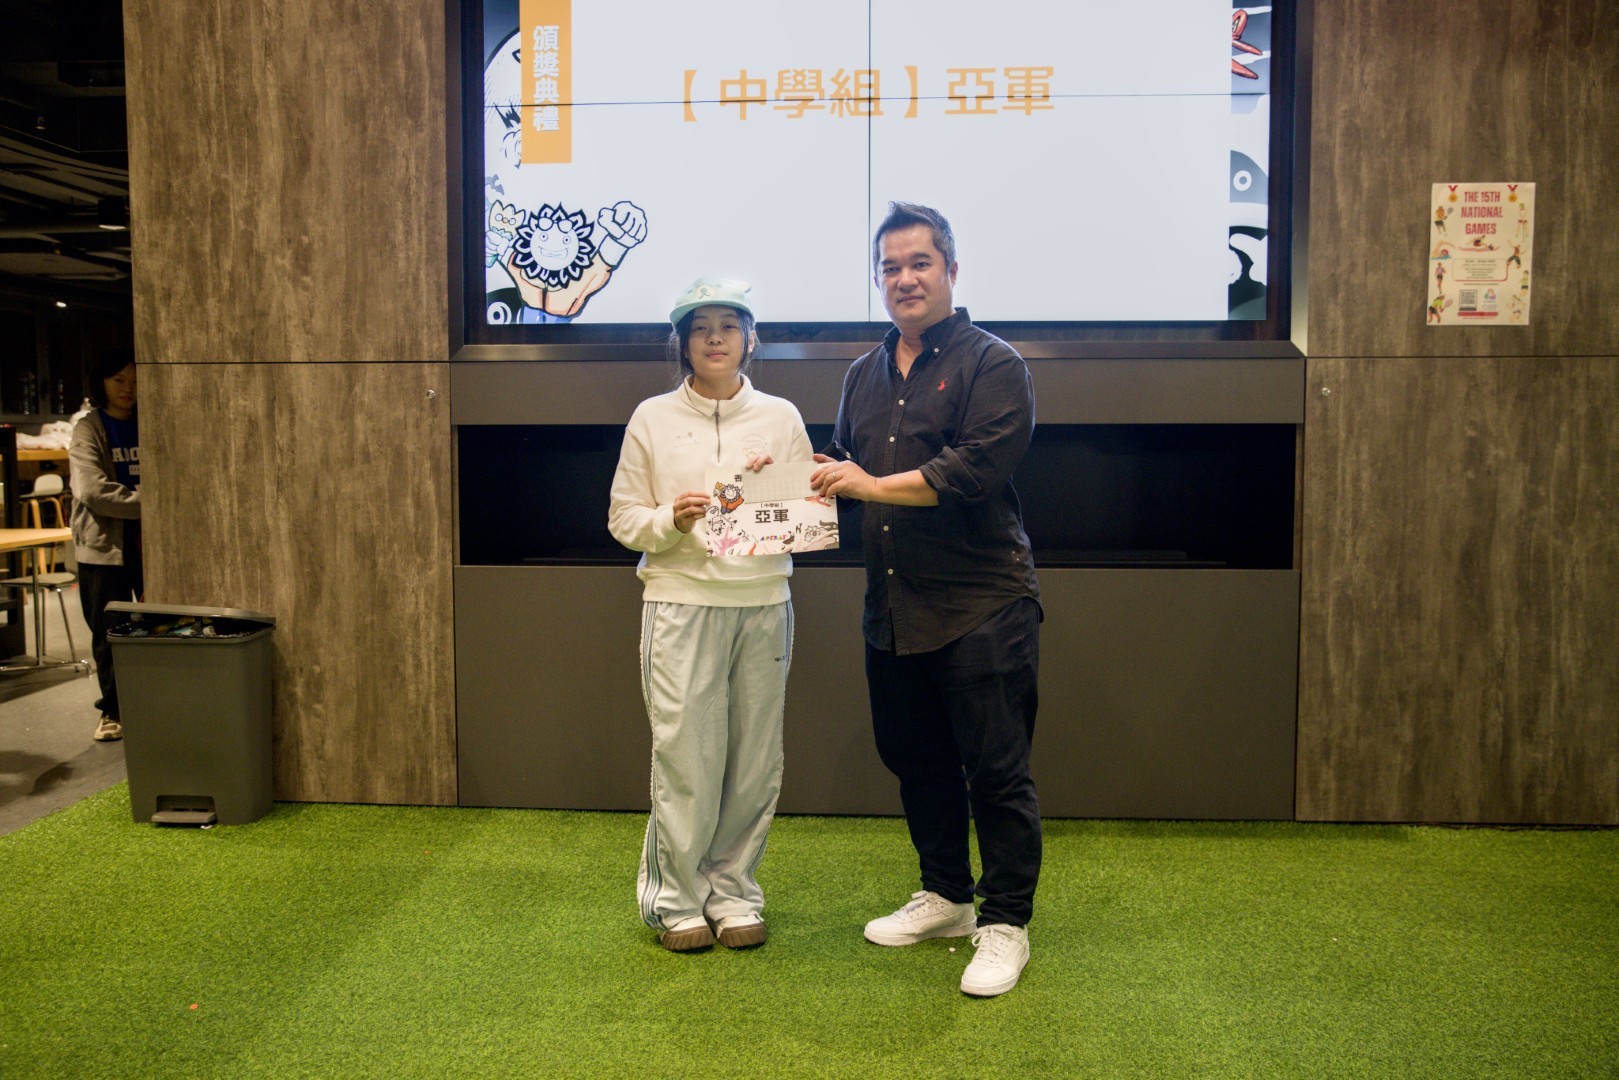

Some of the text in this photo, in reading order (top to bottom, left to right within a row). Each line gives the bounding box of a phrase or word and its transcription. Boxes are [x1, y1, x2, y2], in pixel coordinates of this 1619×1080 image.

[532, 25, 560, 132] 頒獎典禮
[1464, 191, 1501, 203] THE 15TH
[1461, 206, 1503, 218] NATIONAL
[1465, 223, 1497, 234] GAMES
[755, 509, 789, 523] 亞軍
